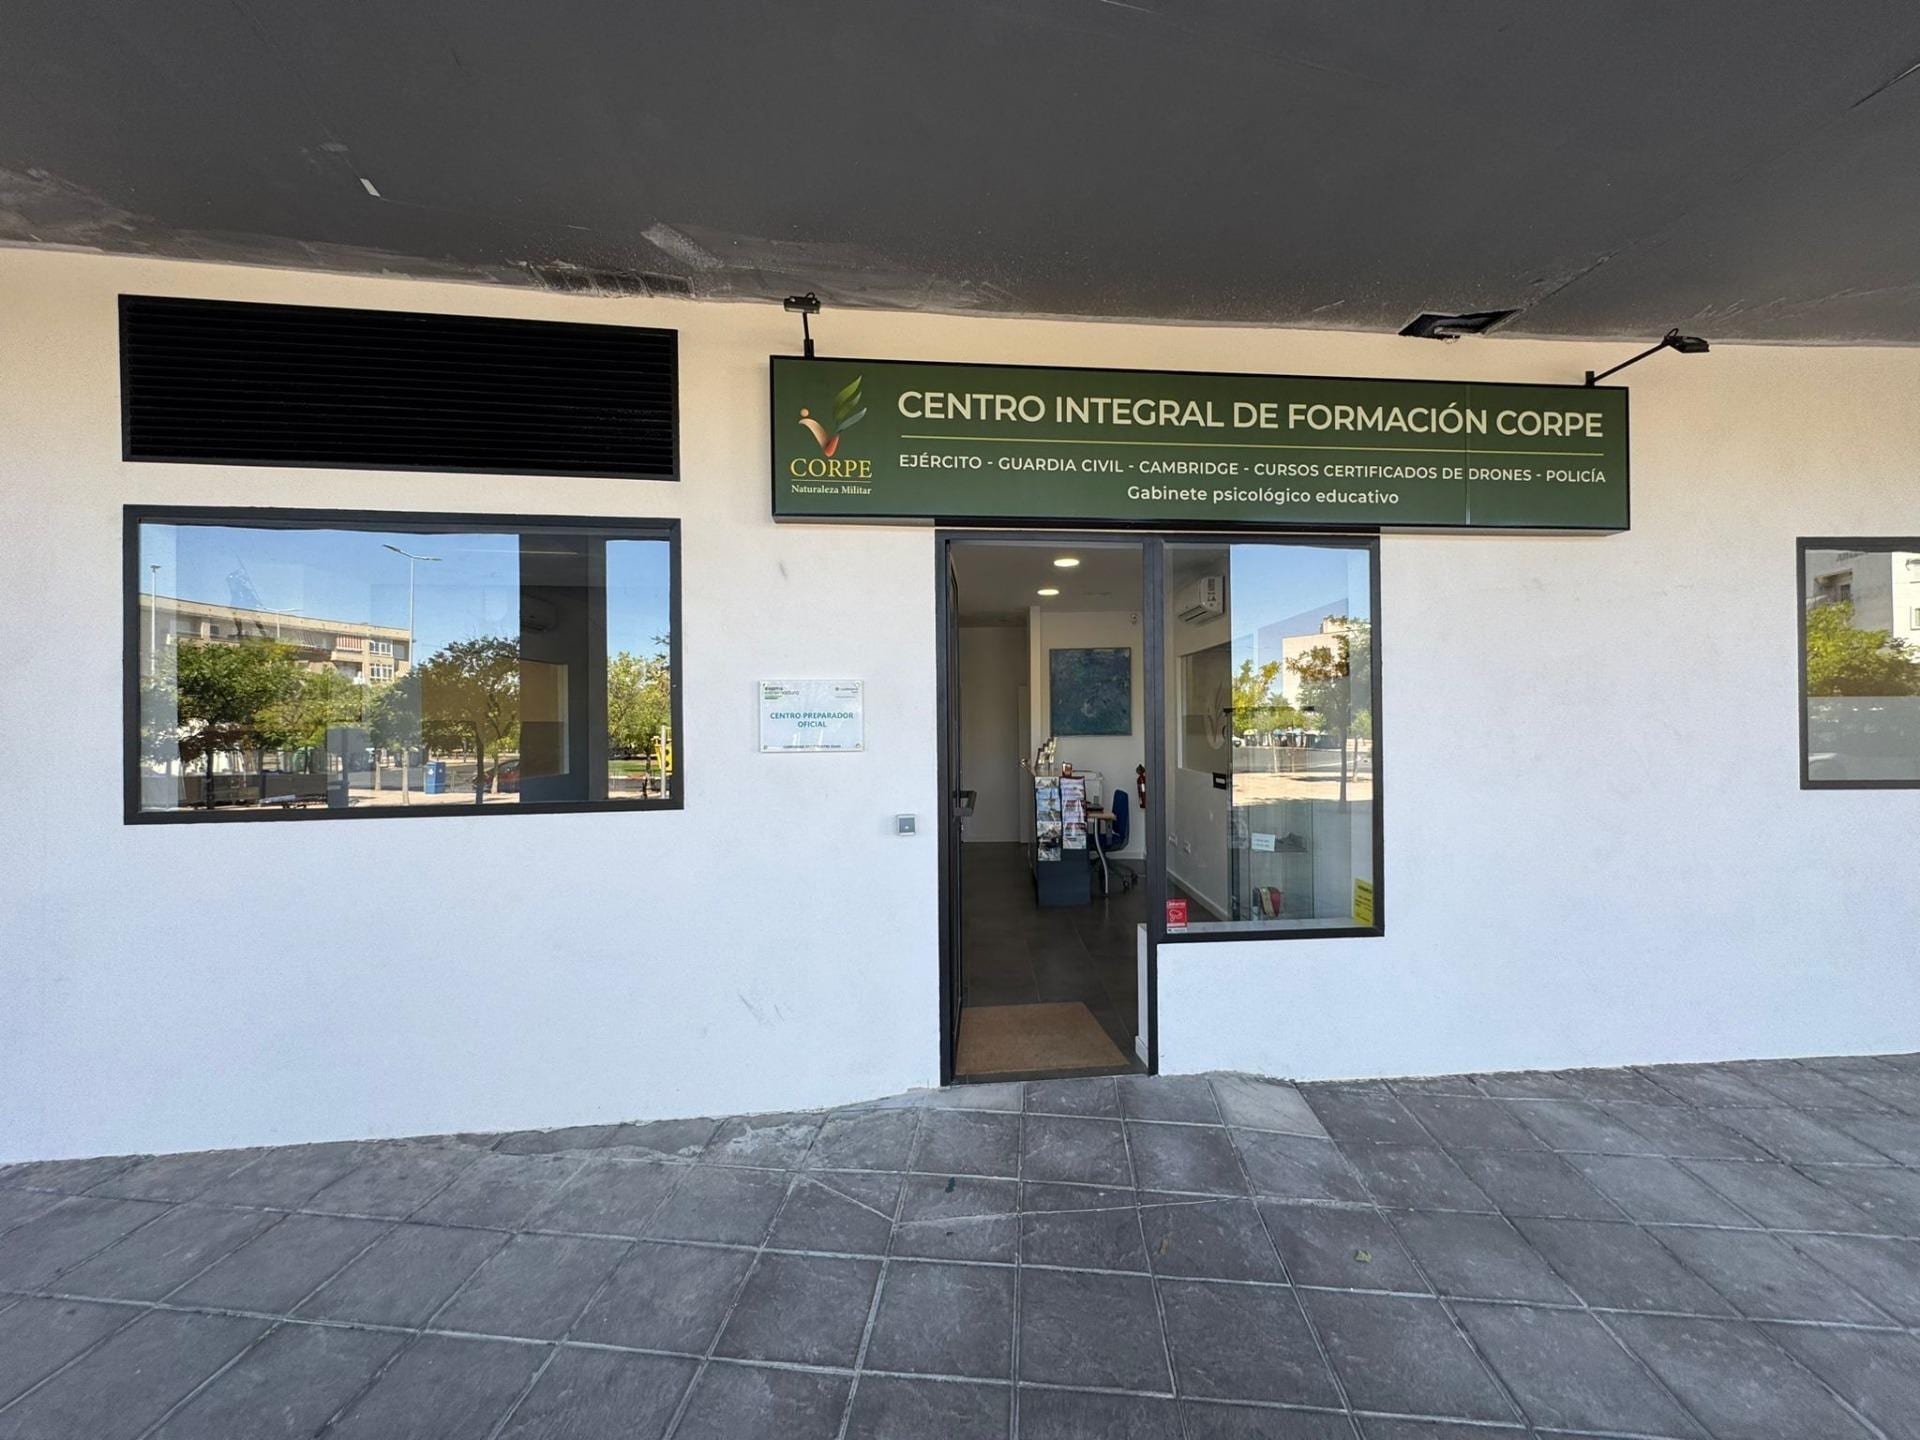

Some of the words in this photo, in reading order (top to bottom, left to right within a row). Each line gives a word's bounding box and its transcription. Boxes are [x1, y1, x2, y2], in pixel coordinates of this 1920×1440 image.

[897, 390, 1046, 423] CENTRO
[1055, 396, 1225, 427] INTEGRAL
[1233, 401, 1279, 429] DE
[1288, 402, 1488, 435] FORMACIÓN
[1496, 409, 1604, 438] CORPE
[790, 457, 873, 478] CORPE
[899, 451, 982, 470] EJÉRCITO
[998, 456, 1077, 472] GUARDIA
[1081, 458, 1124, 473] CIVIL
[1138, 460, 1239, 475] CAMBRIDGE
[1253, 463, 1320, 477] CURSOS
[1323, 464, 1438, 480] CERTIFICADOS
[1442, 467, 1464, 480] DE
[1468, 467, 1533, 482] DRONES
[1546, 467, 1607, 483] POLICÍA
[791, 483, 840, 494] Naturaleza
[841, 485, 872, 495] Militar
[1127, 485, 1208, 501] Gabinete
[1213, 486, 1311, 505] psicológico
[1315, 488, 1399, 504] educativo
